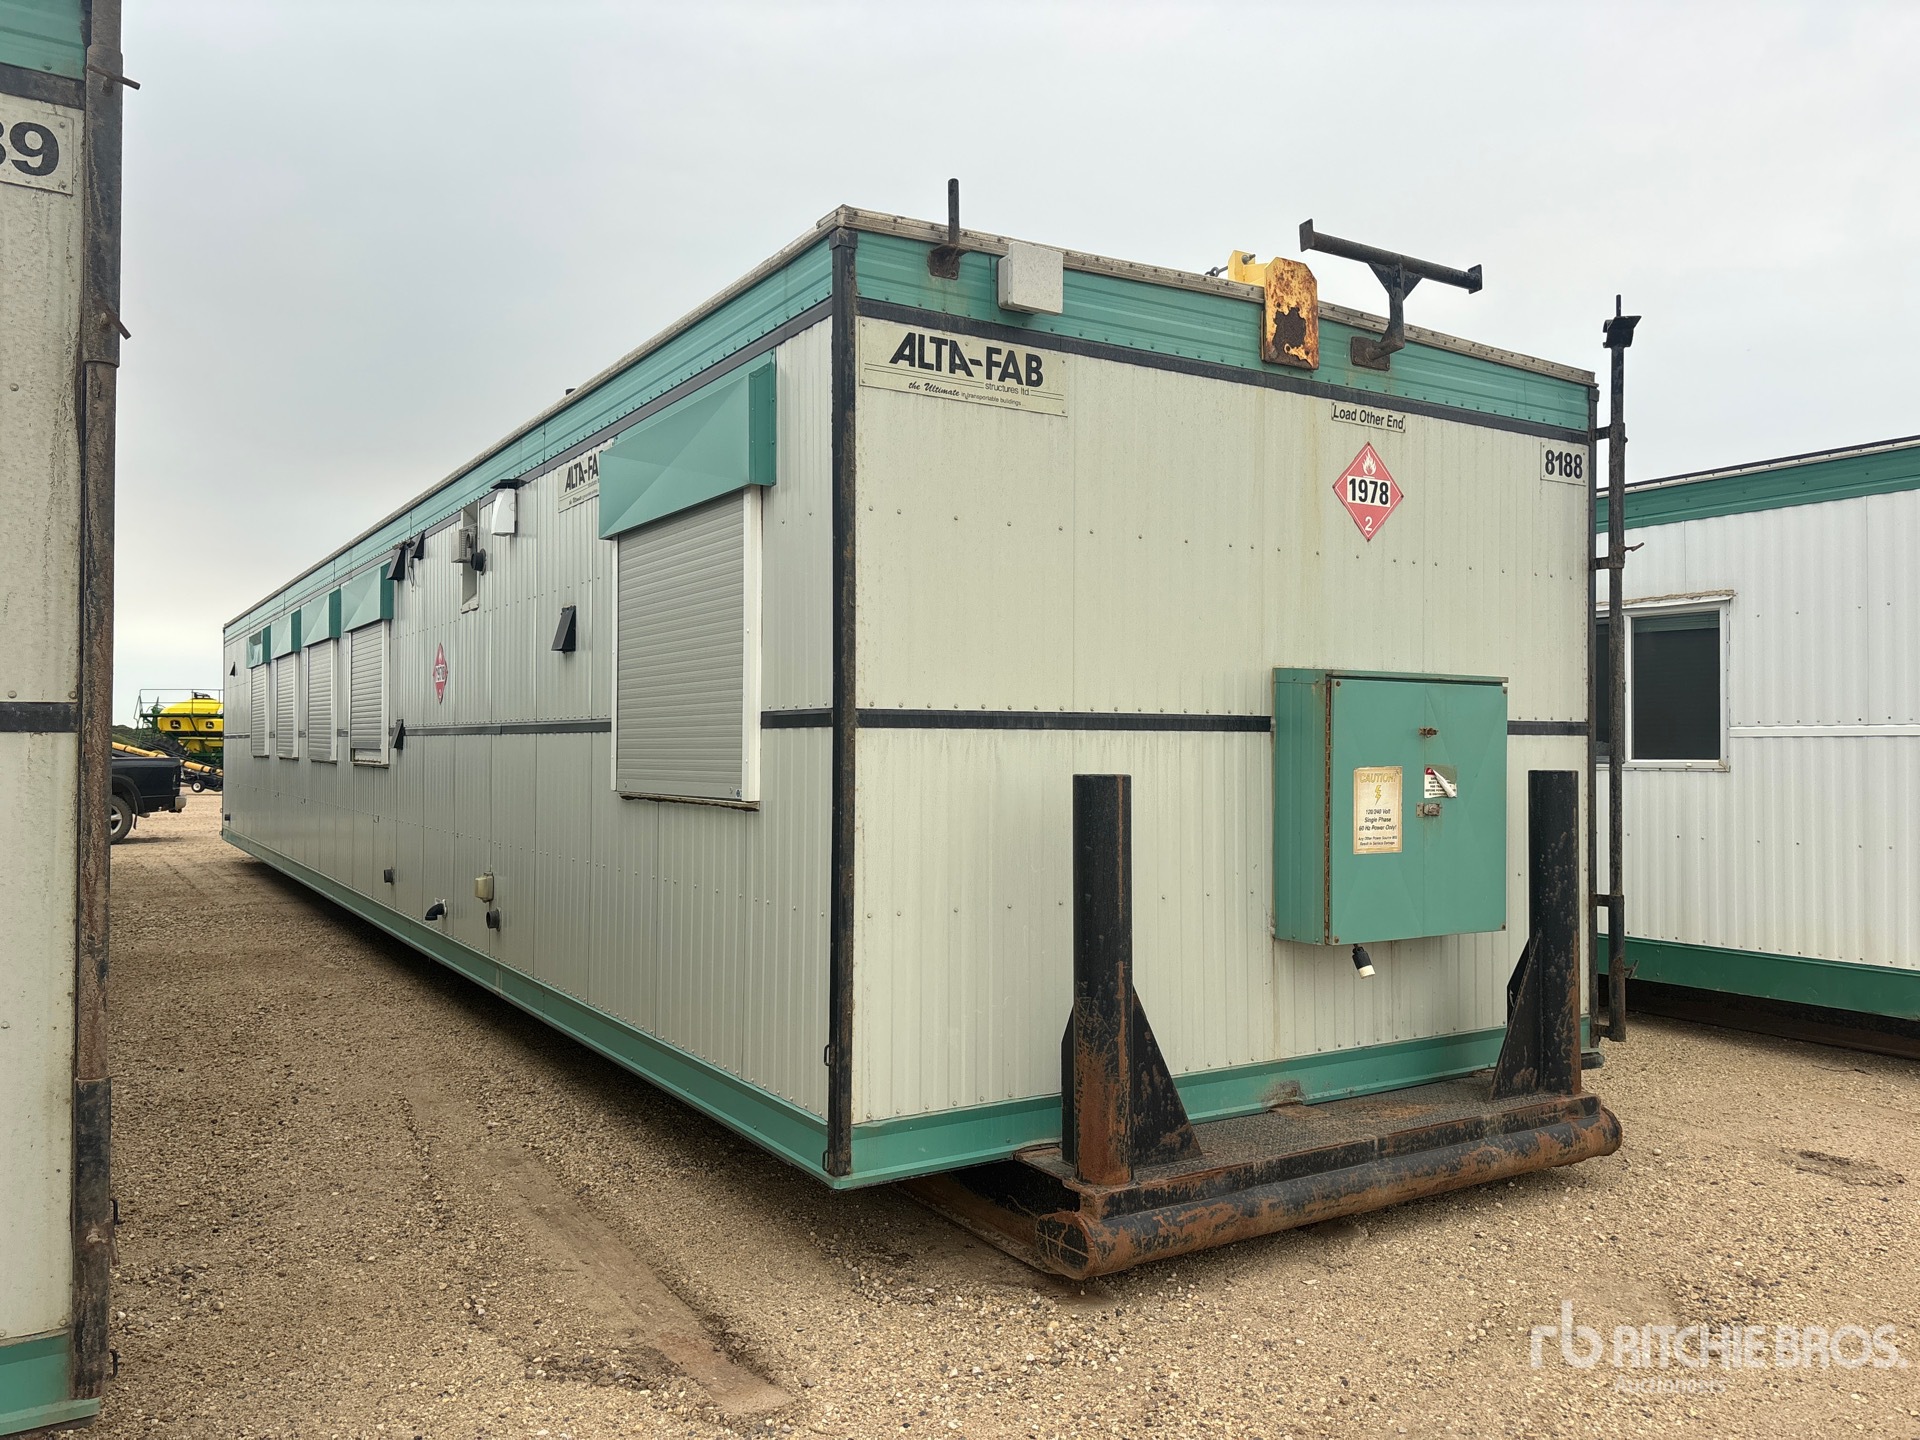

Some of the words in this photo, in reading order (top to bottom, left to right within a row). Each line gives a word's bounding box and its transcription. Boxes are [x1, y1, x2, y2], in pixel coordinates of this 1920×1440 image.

[0, 121, 59, 177] 9
[889, 332, 1044, 388] ALTA-FAB
[908, 381, 921, 391] the
[923, 382, 960, 397] Ultimate
[985, 382, 1019, 395] structures
[1333, 405, 1357, 421] Load
[1360, 409, 1385, 426] Other
[1387, 414, 1404, 430] End
[565, 453, 599, 493] ALTA-FA
[1545, 449, 1583, 479] 8188
[1348, 478, 1389, 505] 1978
[1364, 516, 1373, 531] 2
